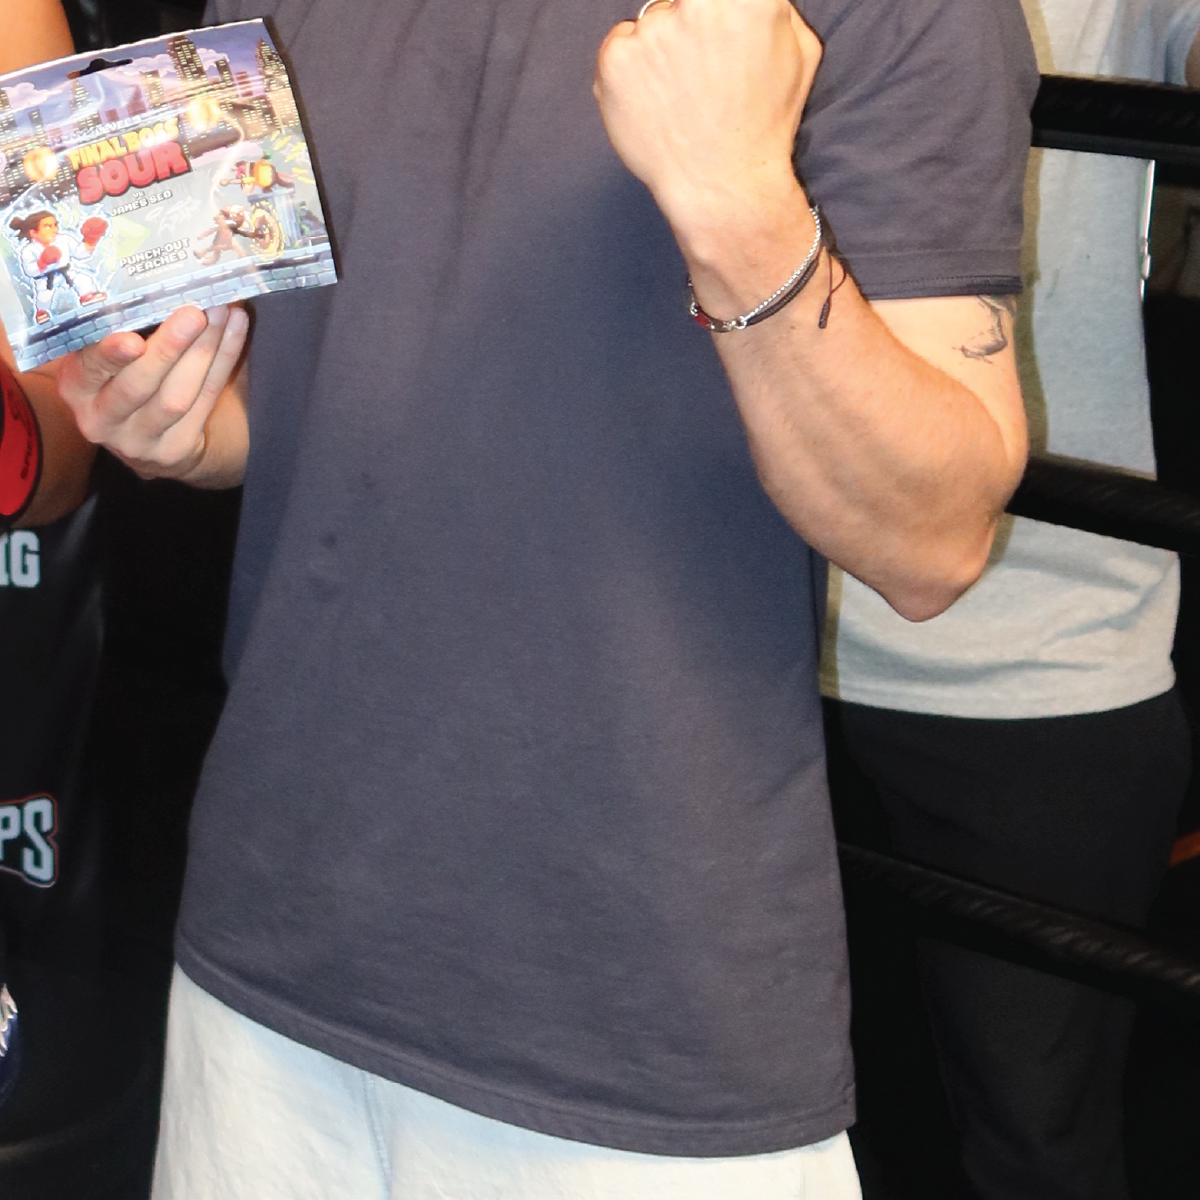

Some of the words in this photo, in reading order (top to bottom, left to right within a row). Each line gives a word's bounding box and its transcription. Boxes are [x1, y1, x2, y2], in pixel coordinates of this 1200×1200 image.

[66, 136, 127, 171] FINAL
[76, 141, 191, 205] SOUR
[109, 198, 148, 217] JAMES
[149, 189, 173, 204] SEO
[120, 237, 190, 267] PUNCH-OUT
[127, 250, 188, 276] PEACHES
